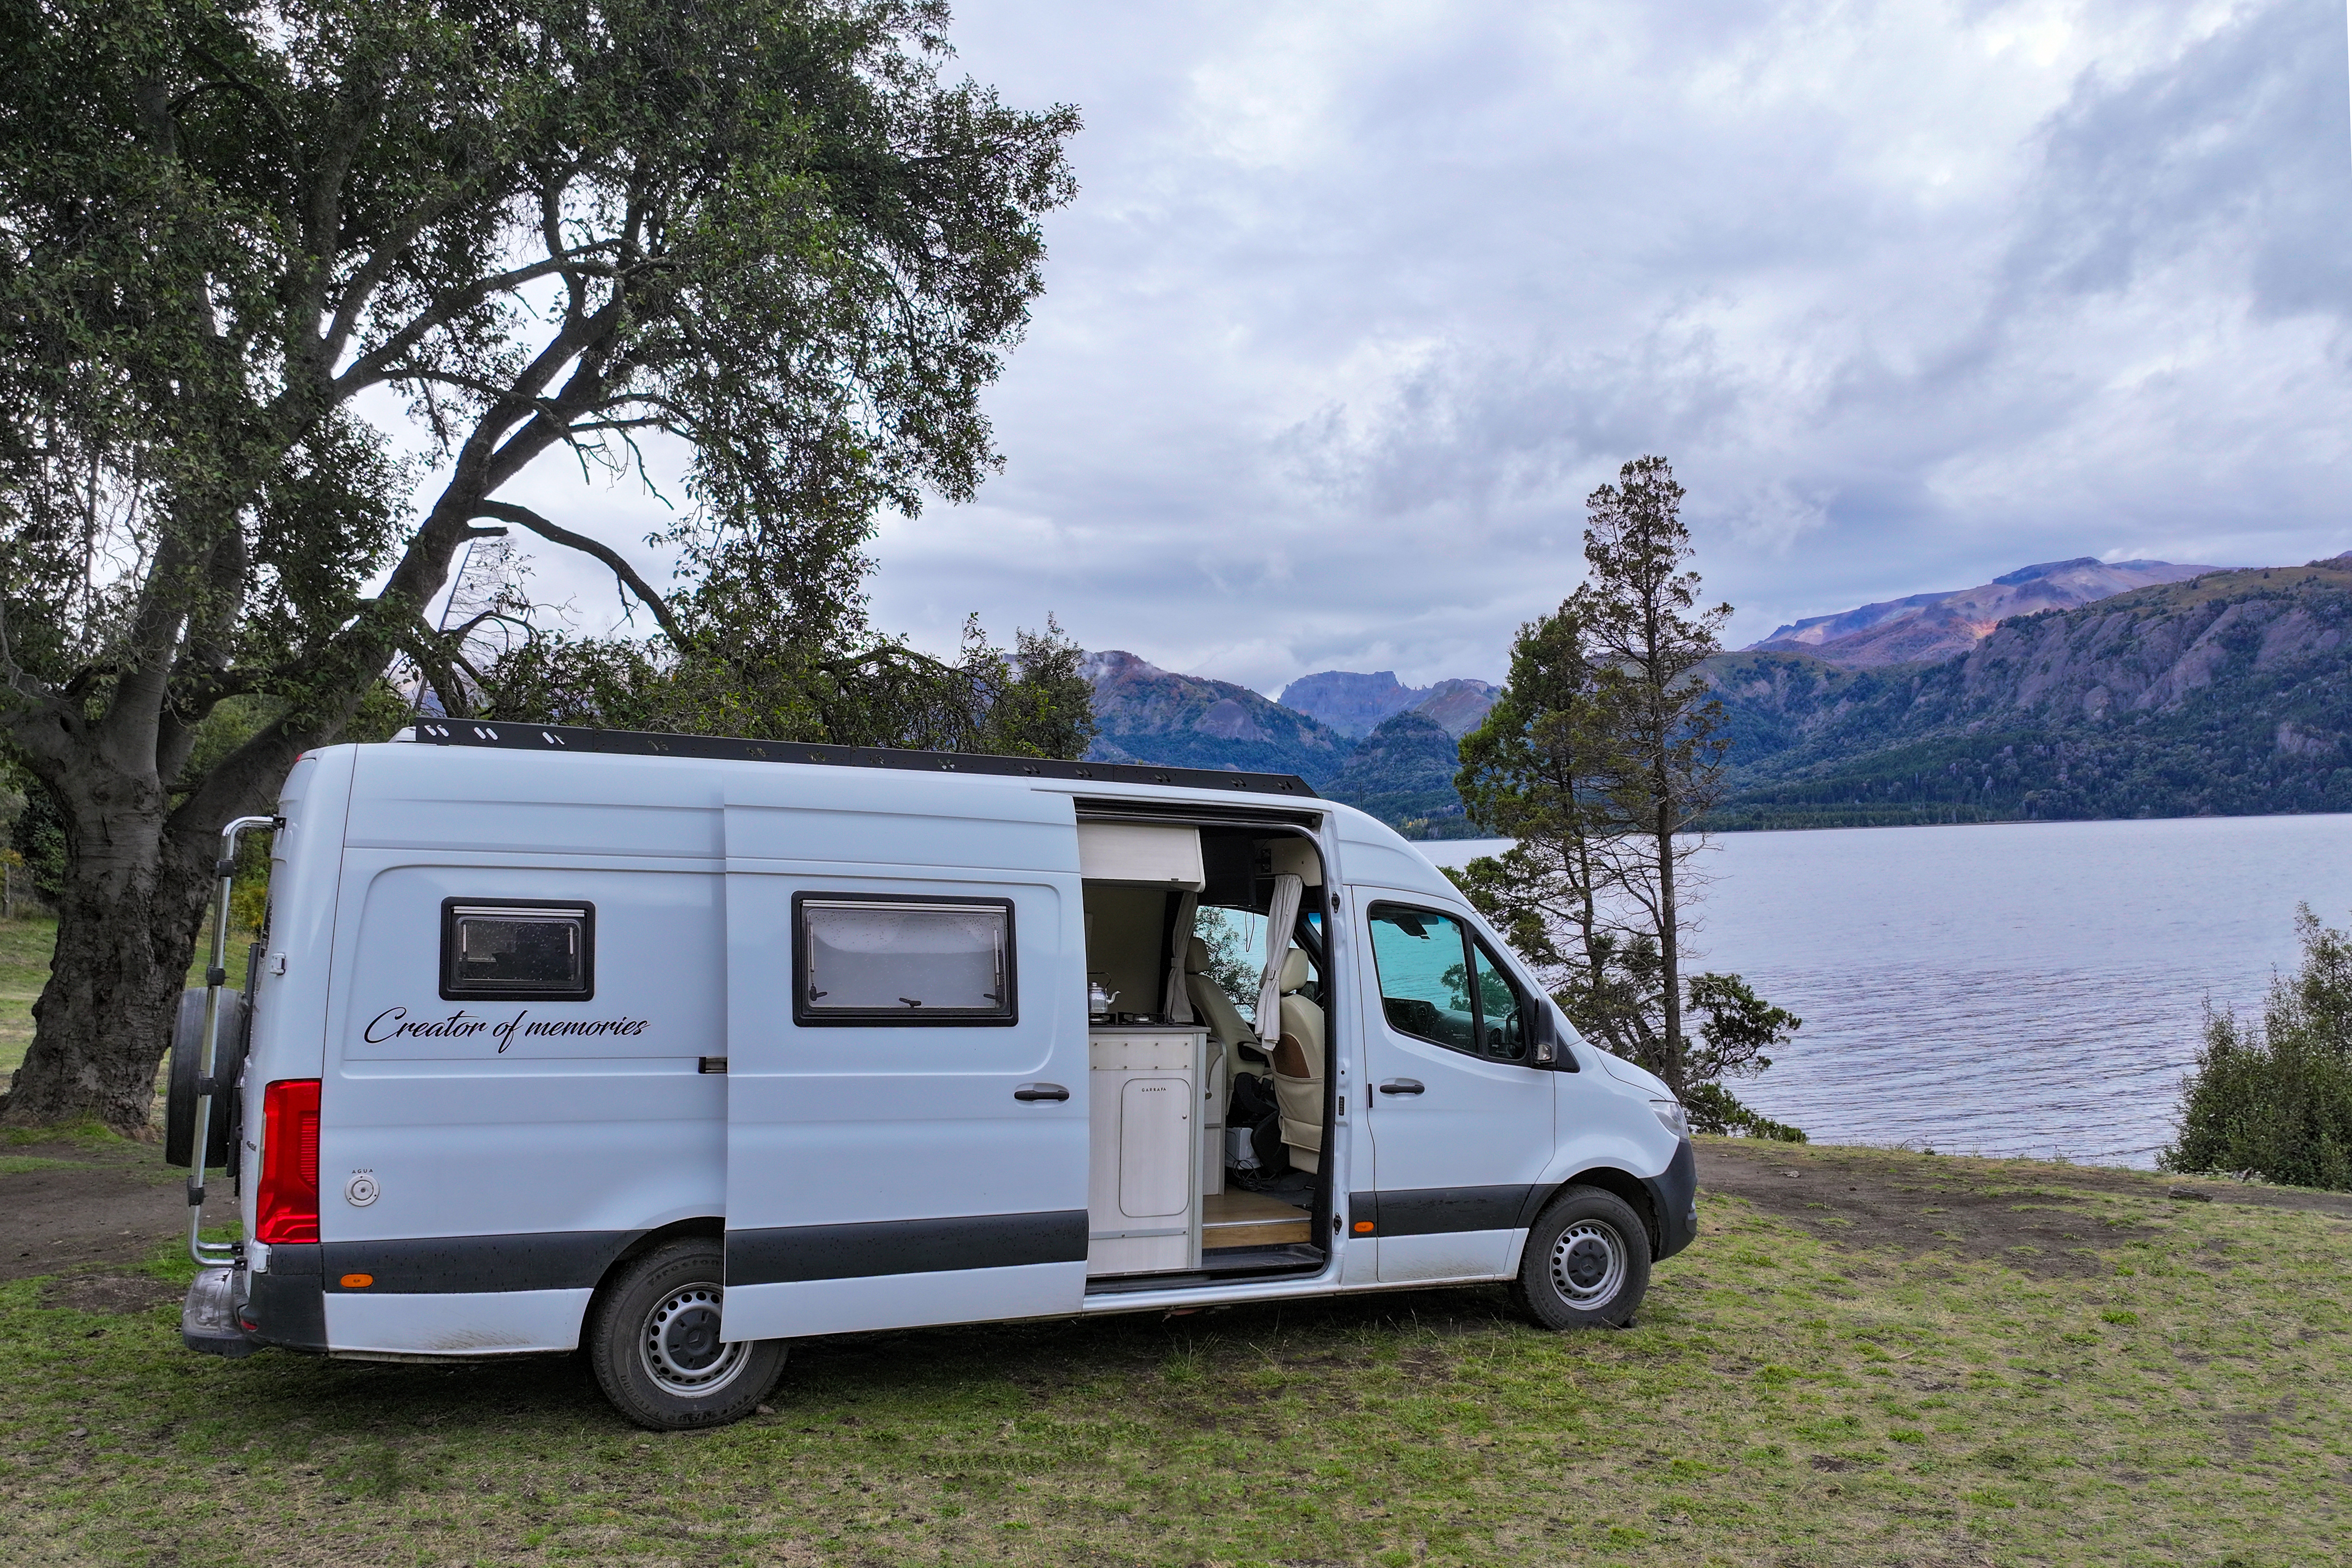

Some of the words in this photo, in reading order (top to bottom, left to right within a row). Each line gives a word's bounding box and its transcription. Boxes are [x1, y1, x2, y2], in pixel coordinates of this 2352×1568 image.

[364, 1007, 488, 1044] Creator
[492, 1010, 528, 1054] of
[525, 1016, 651, 1038] memories
